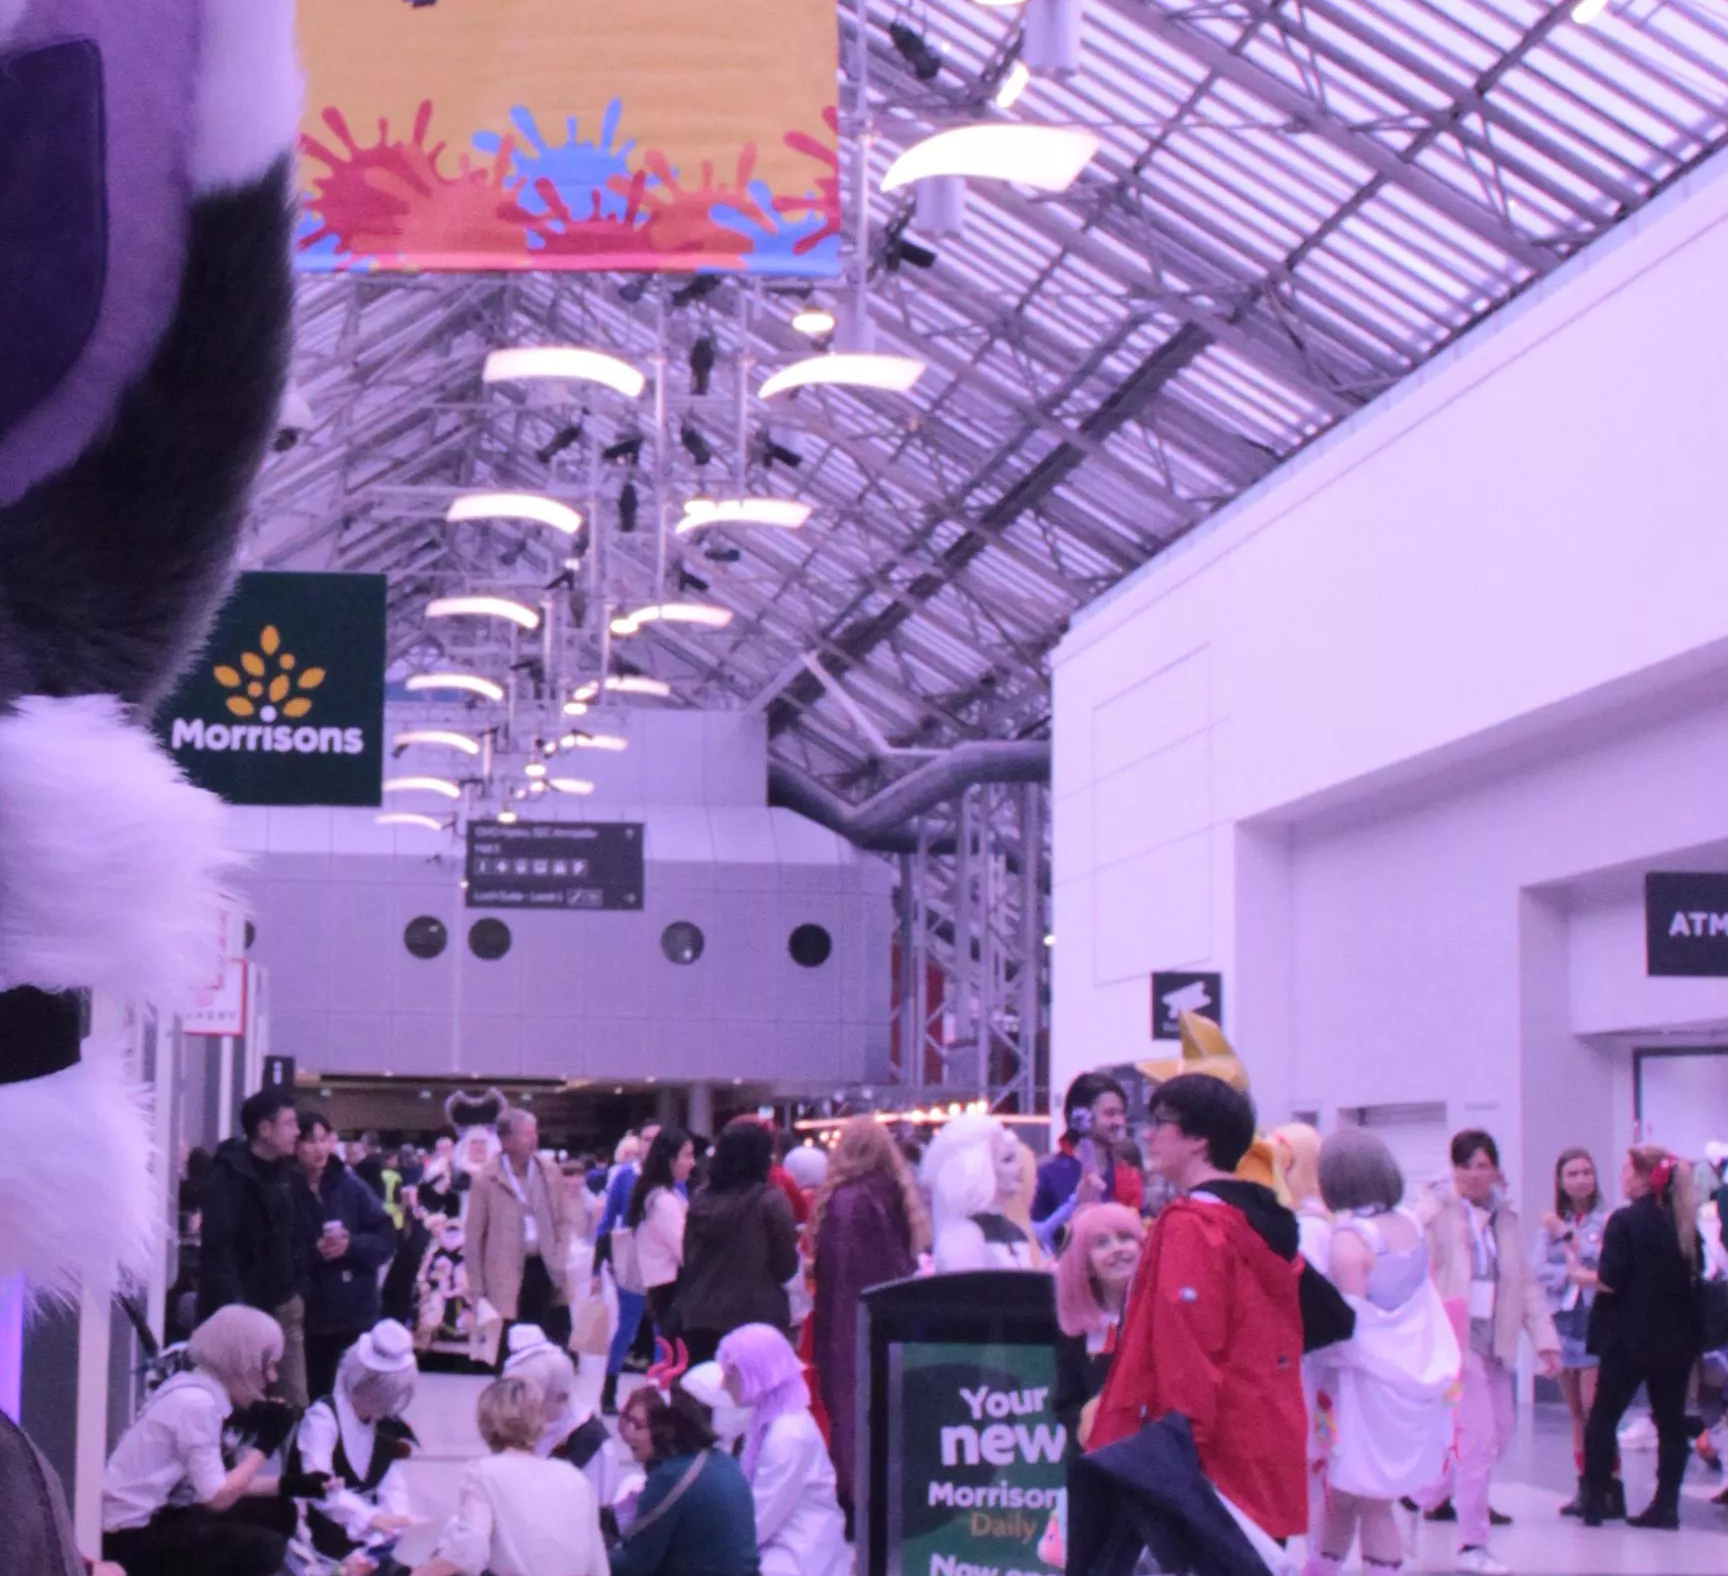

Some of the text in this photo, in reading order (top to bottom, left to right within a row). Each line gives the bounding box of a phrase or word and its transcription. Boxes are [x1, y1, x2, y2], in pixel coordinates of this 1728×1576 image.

[172, 718, 364, 754] Morrisons
[959, 1385, 1049, 1420] Your
[940, 1423, 1067, 1466] new
[928, 1480, 1058, 1508] Morrison
[971, 1511, 1036, 1544] Daily
